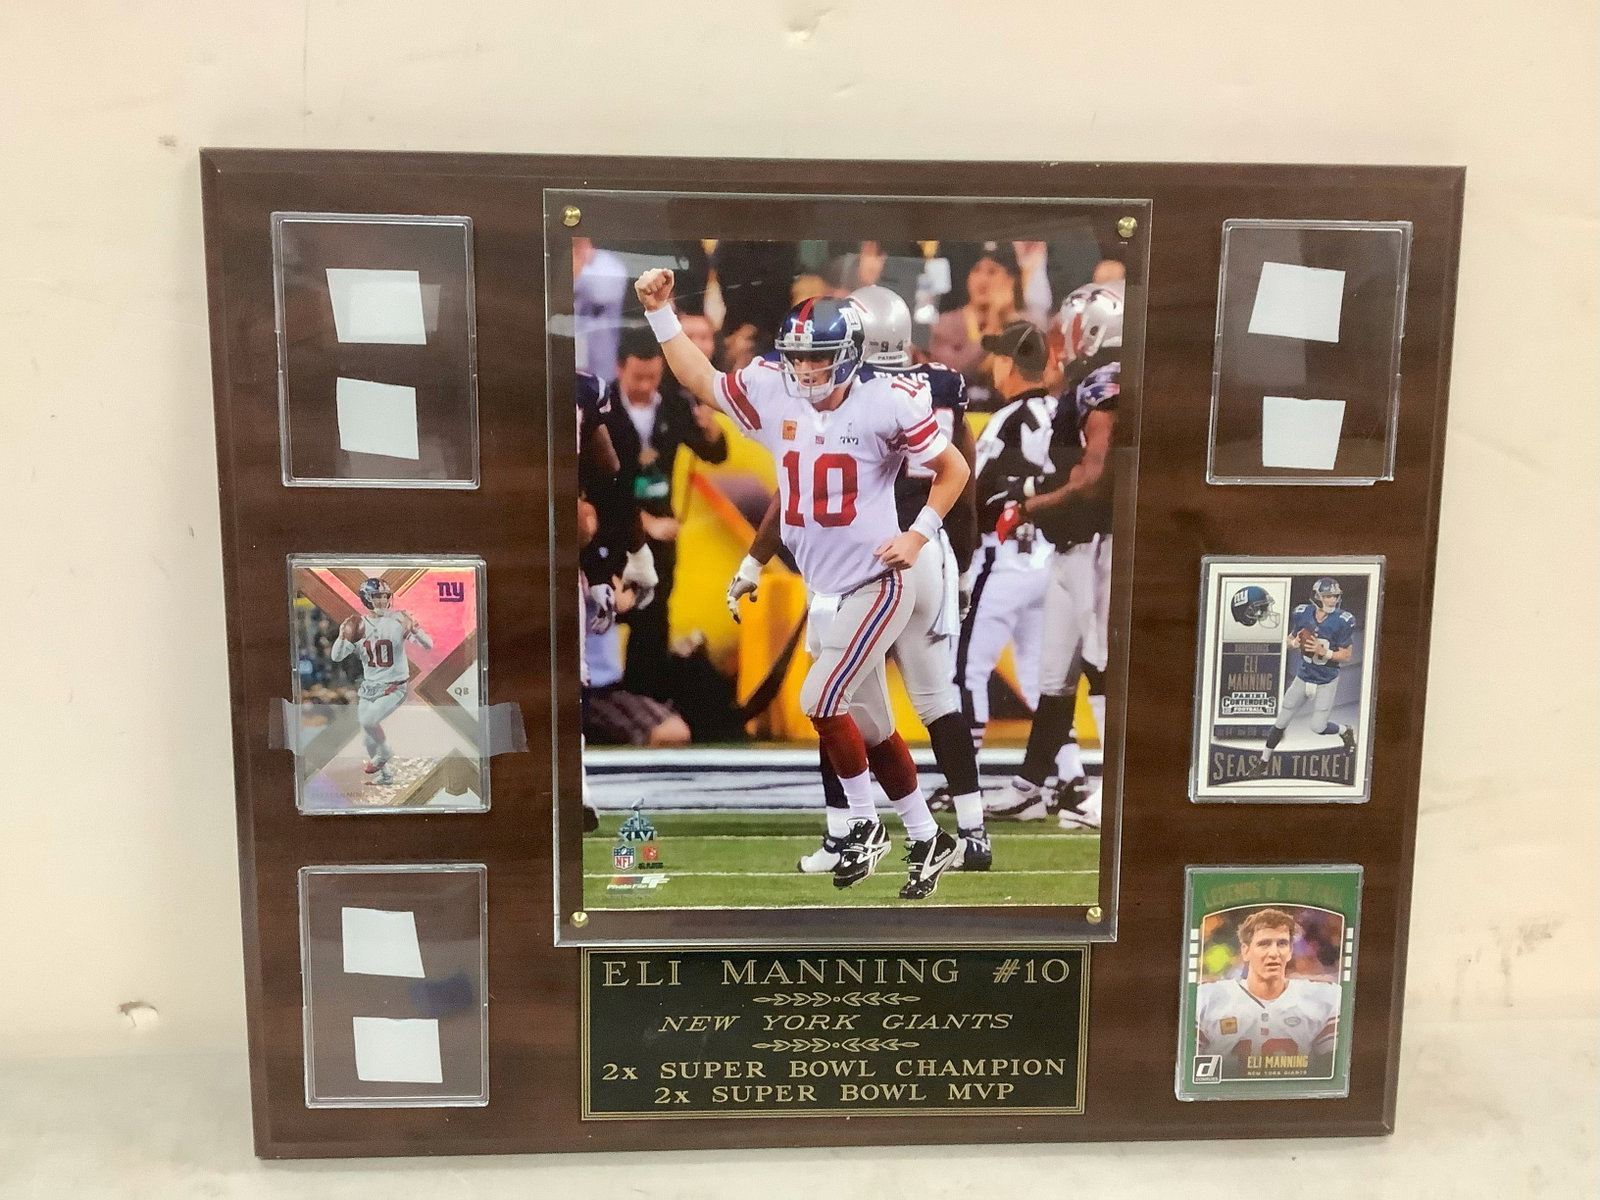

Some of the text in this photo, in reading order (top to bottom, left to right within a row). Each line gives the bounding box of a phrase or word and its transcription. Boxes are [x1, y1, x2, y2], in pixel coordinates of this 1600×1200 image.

[782, 451, 858, 528] 10
[363, 639, 394, 668] 10
[1244, 655, 1259, 672] ELI
[1228, 673, 1273, 691] MANNING
[454, 687, 470, 696] QB
[1223, 697, 1276, 708] CONTENDERS
[1213, 752, 1282, 781] SEASN
[618, 831, 658, 841] XLVI
[615, 857, 633, 867] NFL
[602, 958, 1070, 986] ELI MANNING #10
[658, 1013, 1014, 1032] NEW YORK GIANTS
[602, 1058, 1067, 1081] 2x SUPER BOWL CHAMPION
[1247, 1055, 1309, 1068] ELI MANNING
[654, 1083, 1015, 1104] 2x SUPER BOWL MVP
